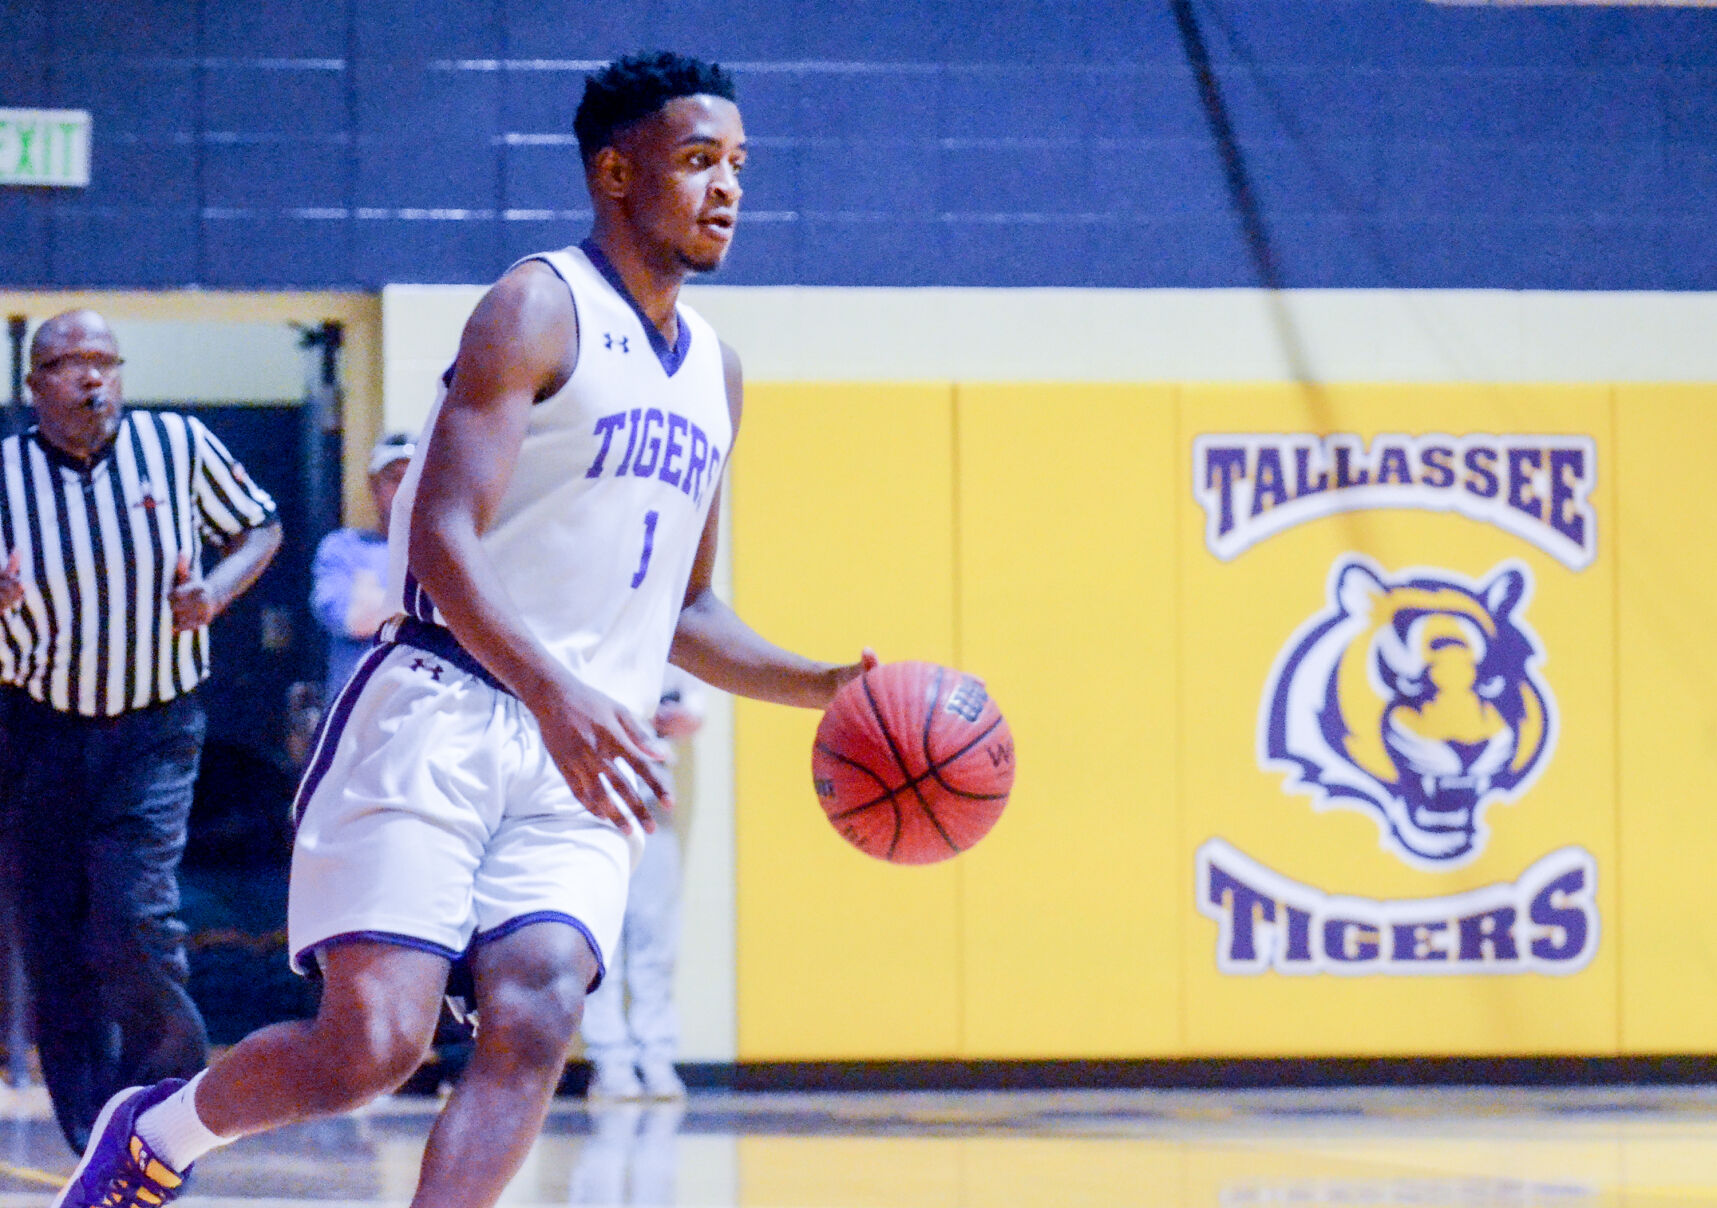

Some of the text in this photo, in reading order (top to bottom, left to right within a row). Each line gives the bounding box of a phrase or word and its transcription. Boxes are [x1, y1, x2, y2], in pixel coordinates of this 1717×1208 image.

[1205, 446, 1585, 548] TALLASSEE
[631, 509, 659, 590] 1
[1208, 861, 1588, 962] TIGERS
